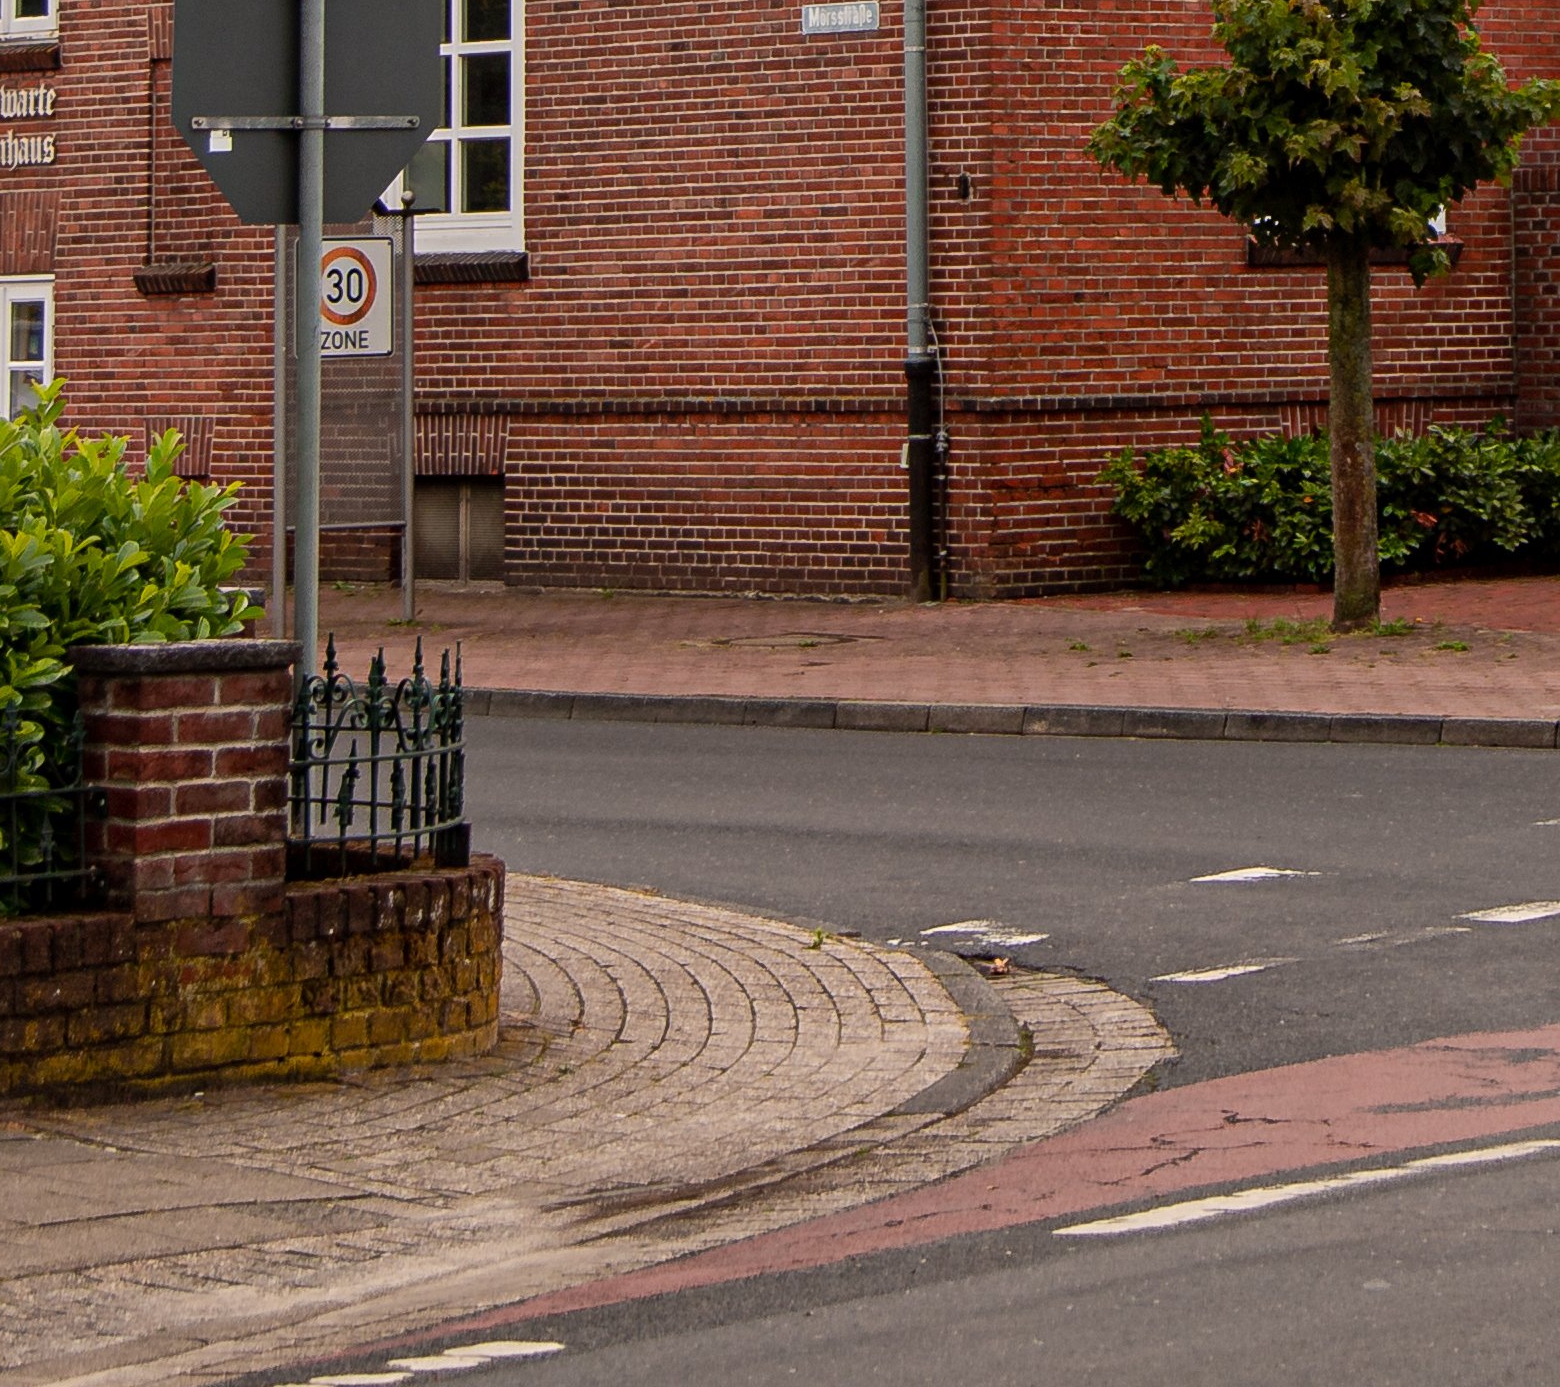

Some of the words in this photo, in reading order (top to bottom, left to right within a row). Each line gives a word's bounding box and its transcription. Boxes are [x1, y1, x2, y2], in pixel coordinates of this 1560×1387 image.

[808, 4, 873, 27] Morsstraße
[326, 268, 363, 303] 30
[320, 330, 369, 350] ZONE
